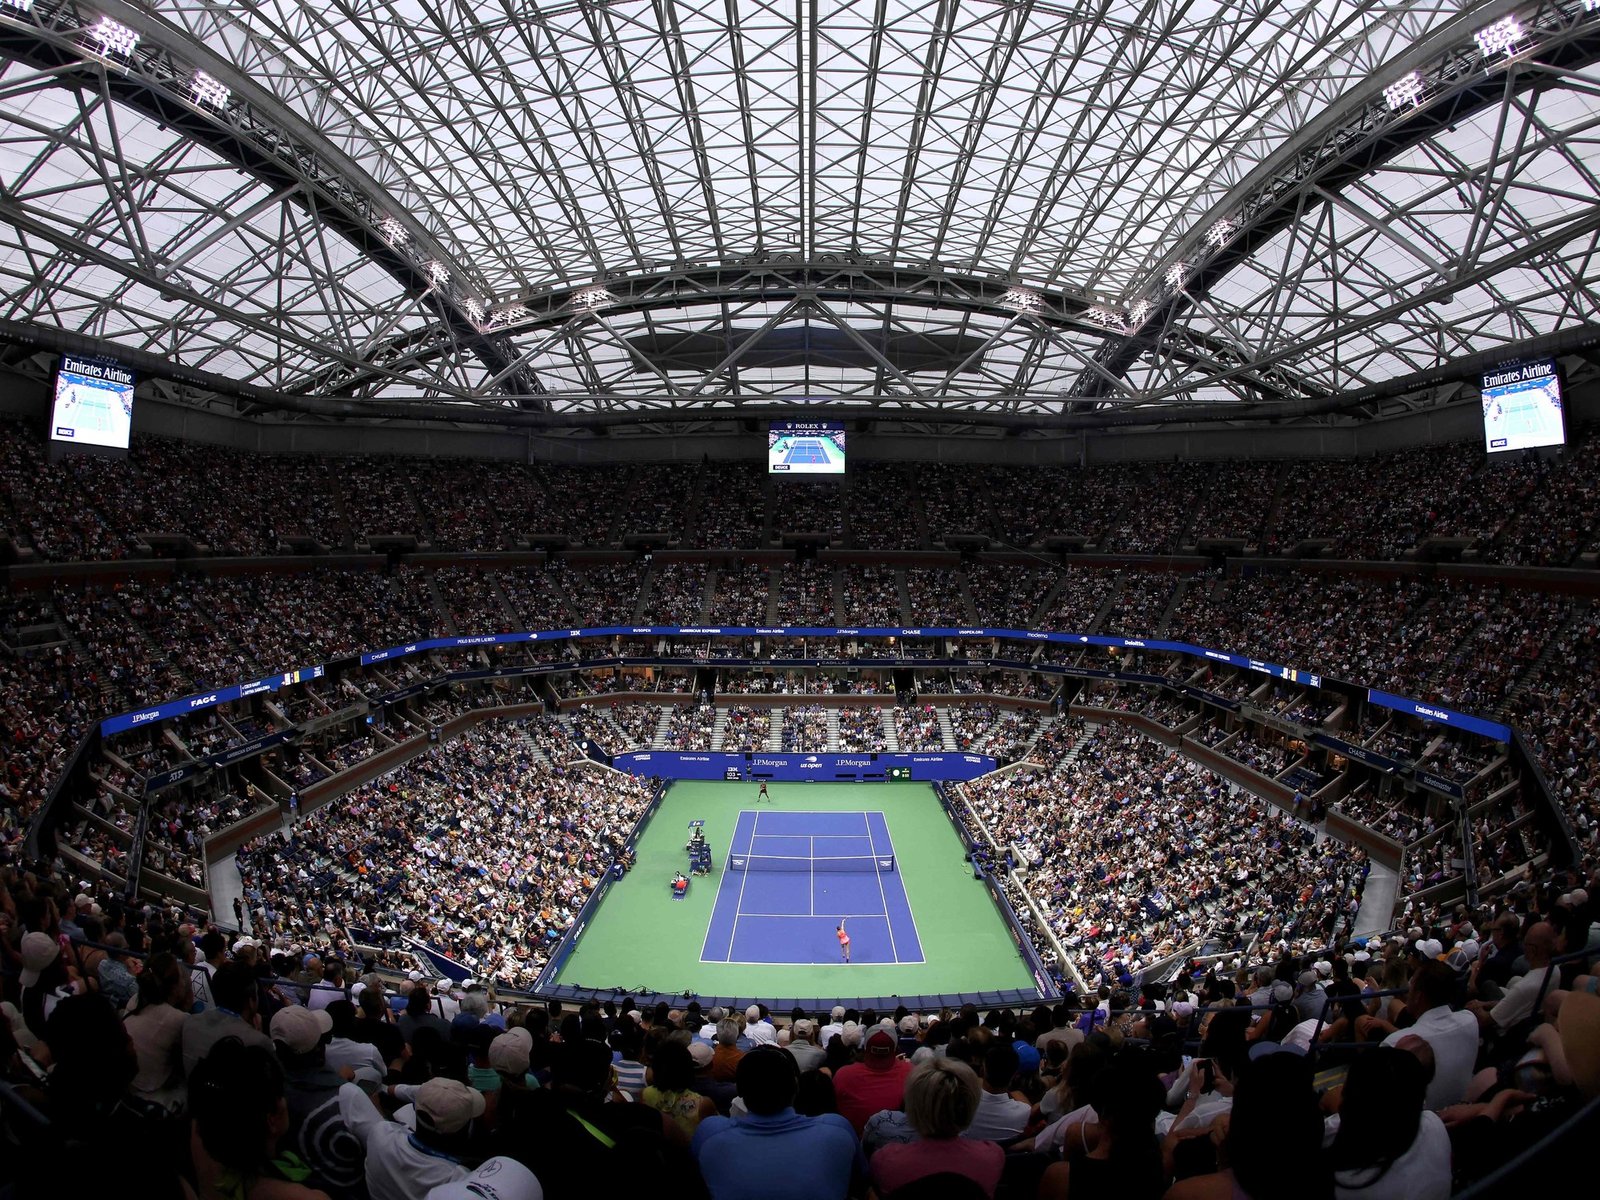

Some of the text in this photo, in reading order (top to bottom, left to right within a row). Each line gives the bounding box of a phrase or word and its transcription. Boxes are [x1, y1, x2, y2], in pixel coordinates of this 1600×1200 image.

[64, 357, 132, 385] Emirates Airline
[1483, 363, 1553, 388] Emirates Airline
[372, 652, 388, 661] CHUBB
[190, 695, 217, 707] FAGE
[1415, 705, 1449, 720] Emirates Airline
[226, 742, 262, 760] AMERICAN EXPRESS
[1348, 746, 1367, 759] CHASE
[752, 759, 788, 767] J.P.Morgan
[835, 759, 871, 768] J.P.Morgan
[573, 921, 586, 941] FAGE
